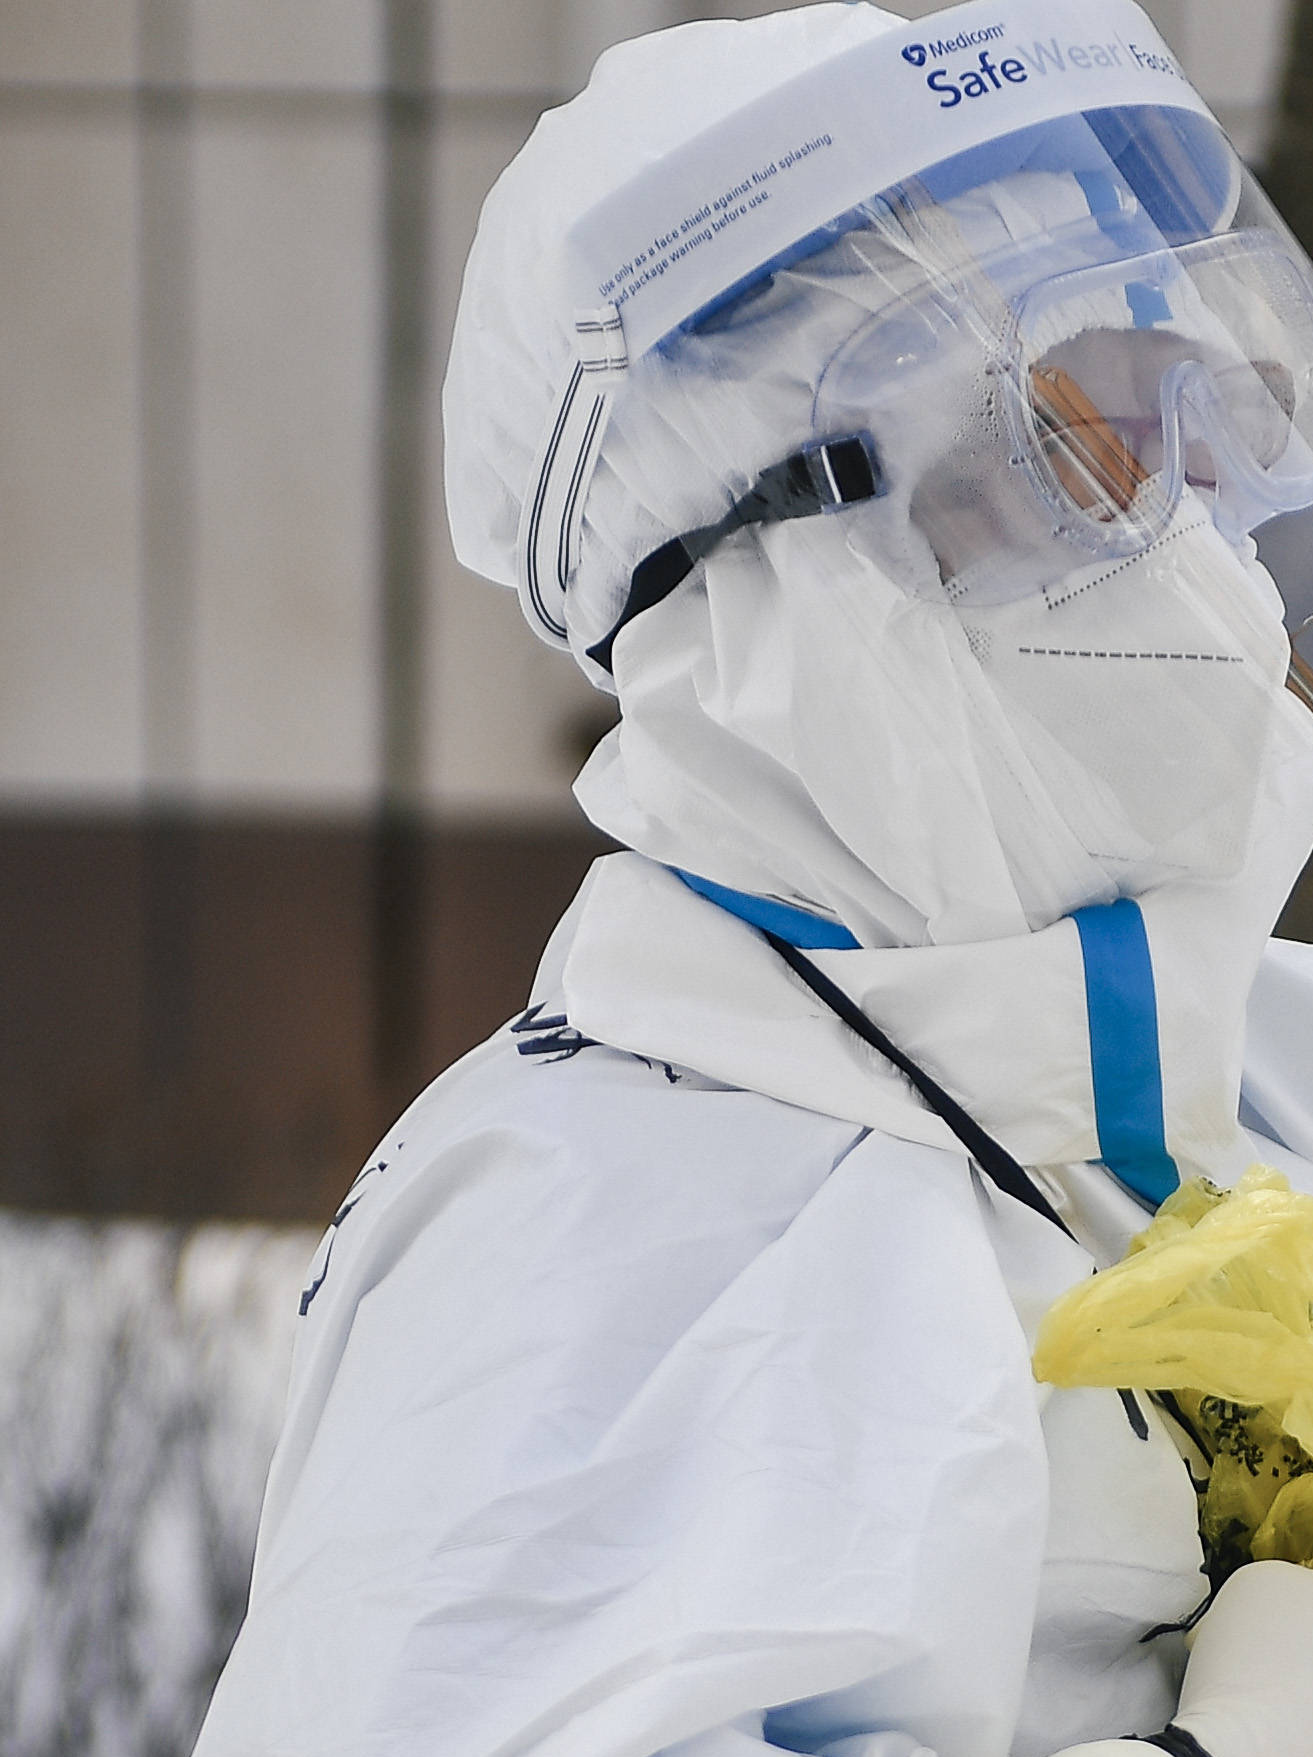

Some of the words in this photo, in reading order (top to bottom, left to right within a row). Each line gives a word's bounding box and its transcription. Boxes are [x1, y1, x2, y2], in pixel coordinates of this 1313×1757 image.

[928, 23, 1003, 59] Medicom
[598, 280, 615, 297] Use
[615, 263, 634, 282] only
[635, 254, 647, 267] as
[648, 247, 655, 256] a
[655, 229, 679, 250] face
[680, 204, 711, 232] shield
[712, 180, 752, 211] against
[752, 163, 777, 184] fluid
[629, 258, 669, 296] package
[669, 228, 713, 262] warning
[711, 204, 747, 233] before
